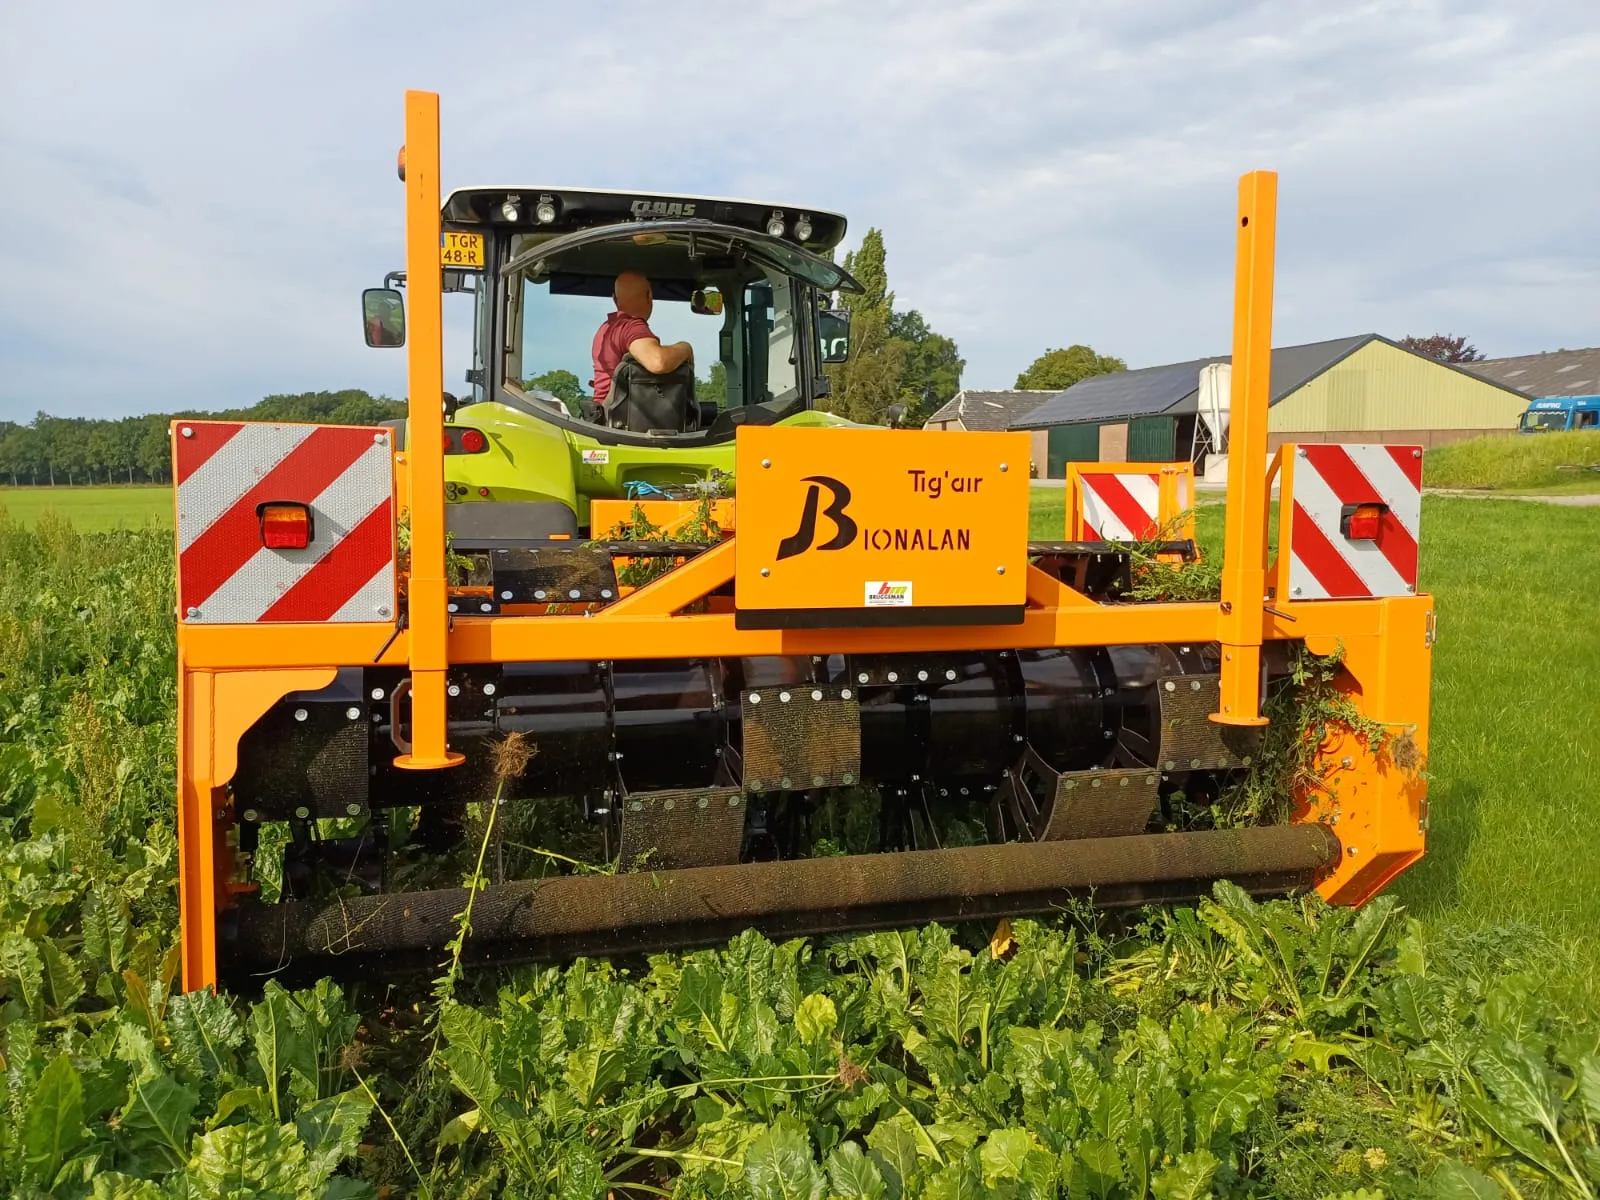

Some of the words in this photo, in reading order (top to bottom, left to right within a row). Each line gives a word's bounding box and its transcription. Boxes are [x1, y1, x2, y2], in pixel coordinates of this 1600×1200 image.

[630, 200, 697, 217] CLAAS
[449, 234, 478, 248] TGR
[443, 249, 477, 263] 48-R
[907, 469, 983, 499] Tig'air
